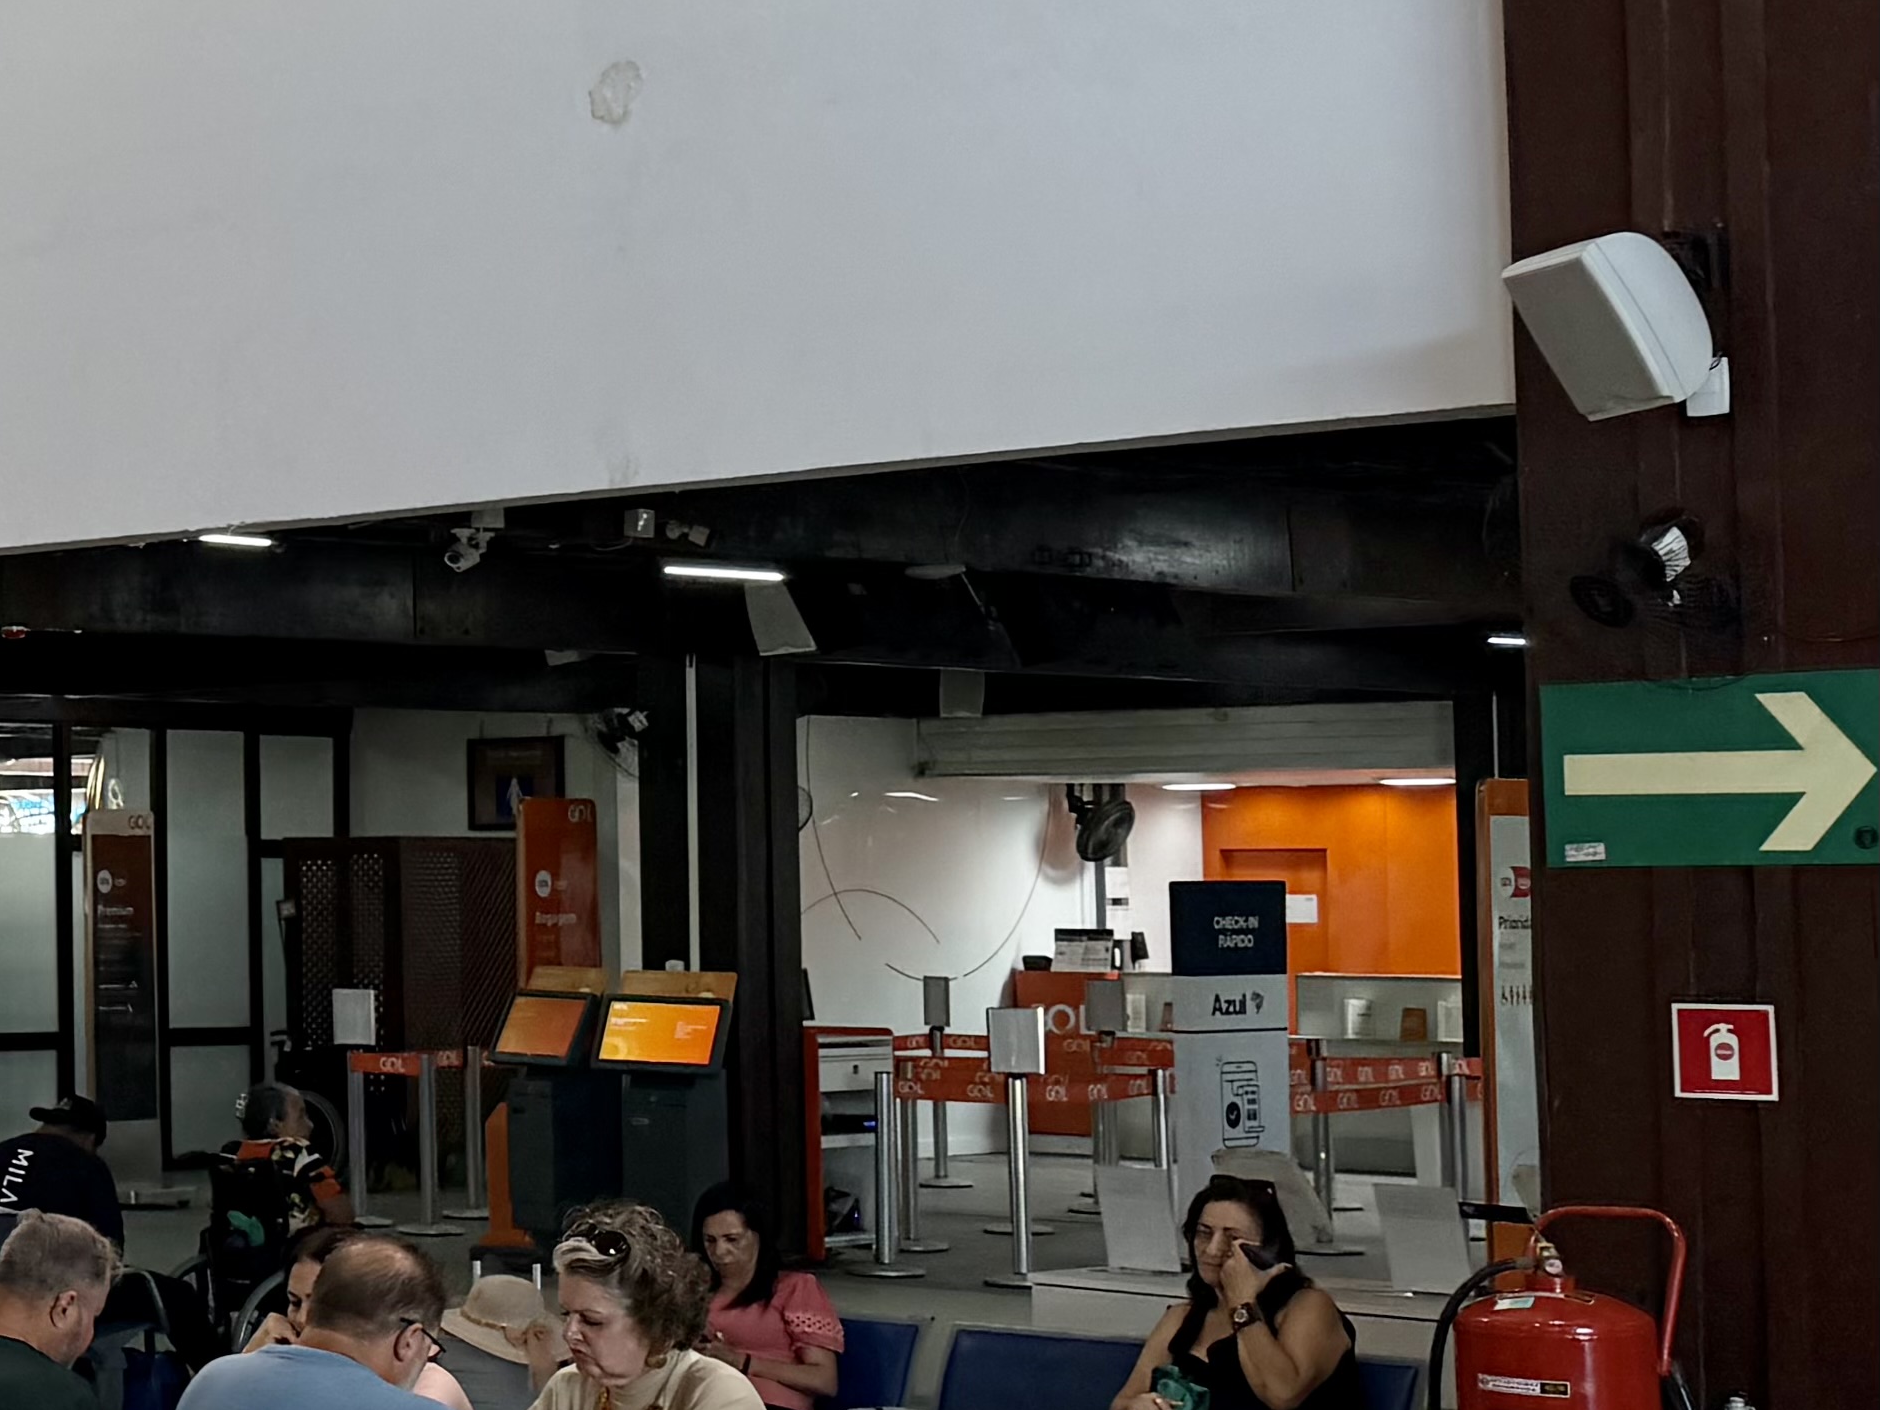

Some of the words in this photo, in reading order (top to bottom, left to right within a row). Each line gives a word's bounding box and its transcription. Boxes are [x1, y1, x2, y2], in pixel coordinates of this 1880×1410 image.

[1213, 915, 1259, 930] CHECK-IN
[1218, 932, 1254, 949] RÁPIDO
[1211, 993, 1247, 1017] Azul
